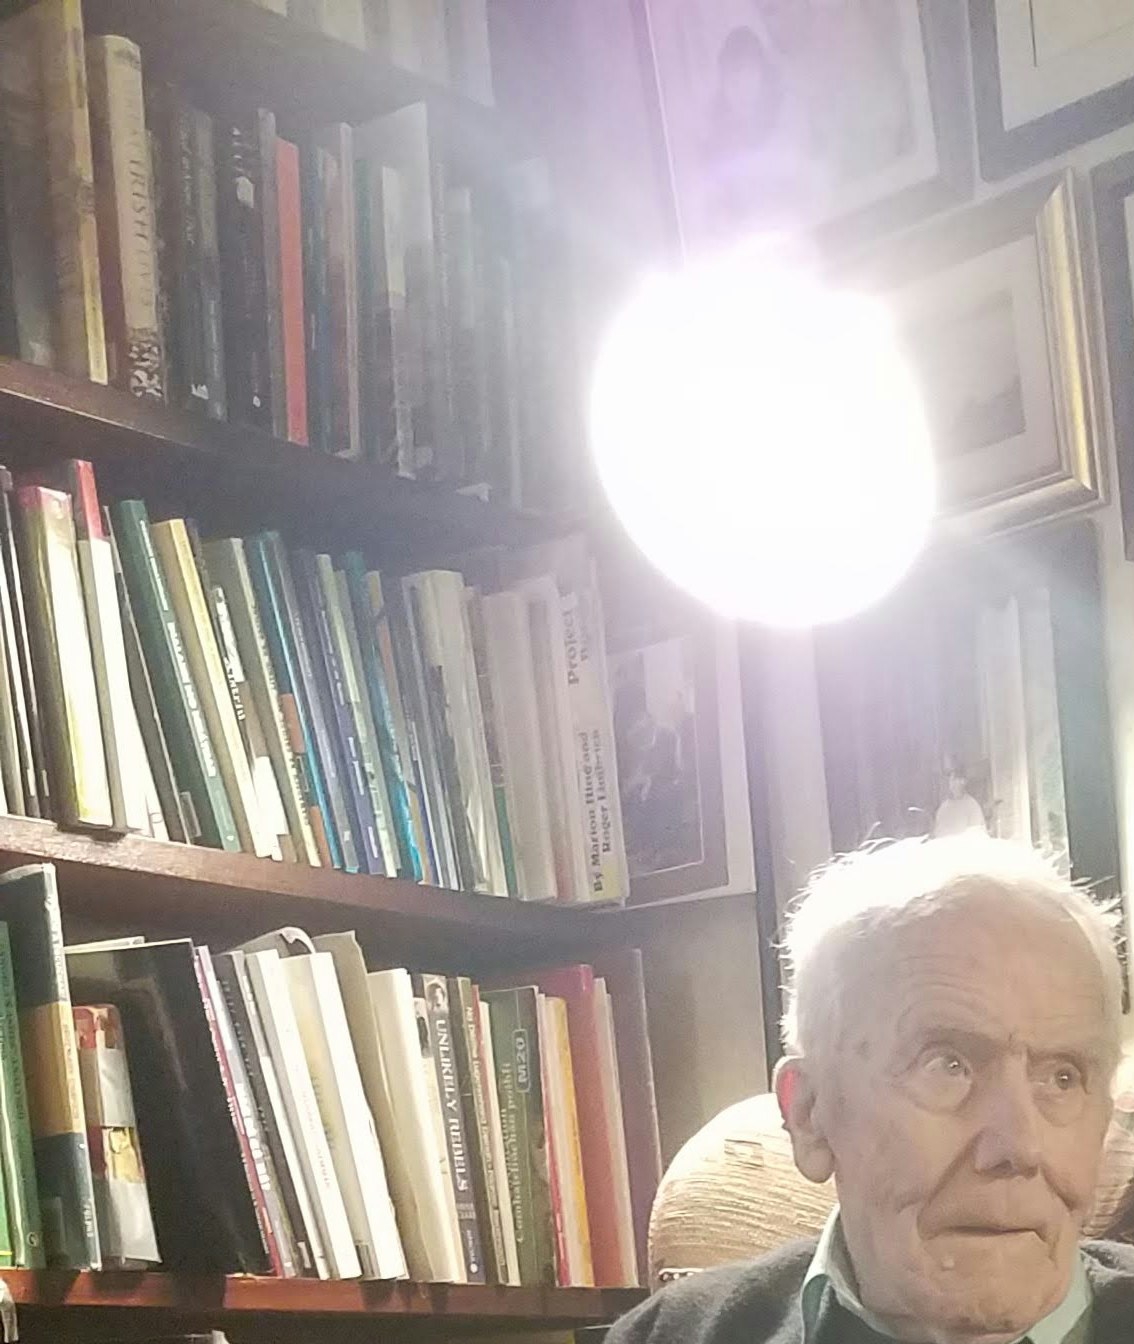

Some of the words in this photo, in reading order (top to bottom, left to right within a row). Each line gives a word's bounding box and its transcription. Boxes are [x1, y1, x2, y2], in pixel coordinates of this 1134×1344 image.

[435, 1019, 458, 1112] UNLIKELY
[449, 1117, 469, 1192] REBELS
[516, 1037, 528, 1083] M20
